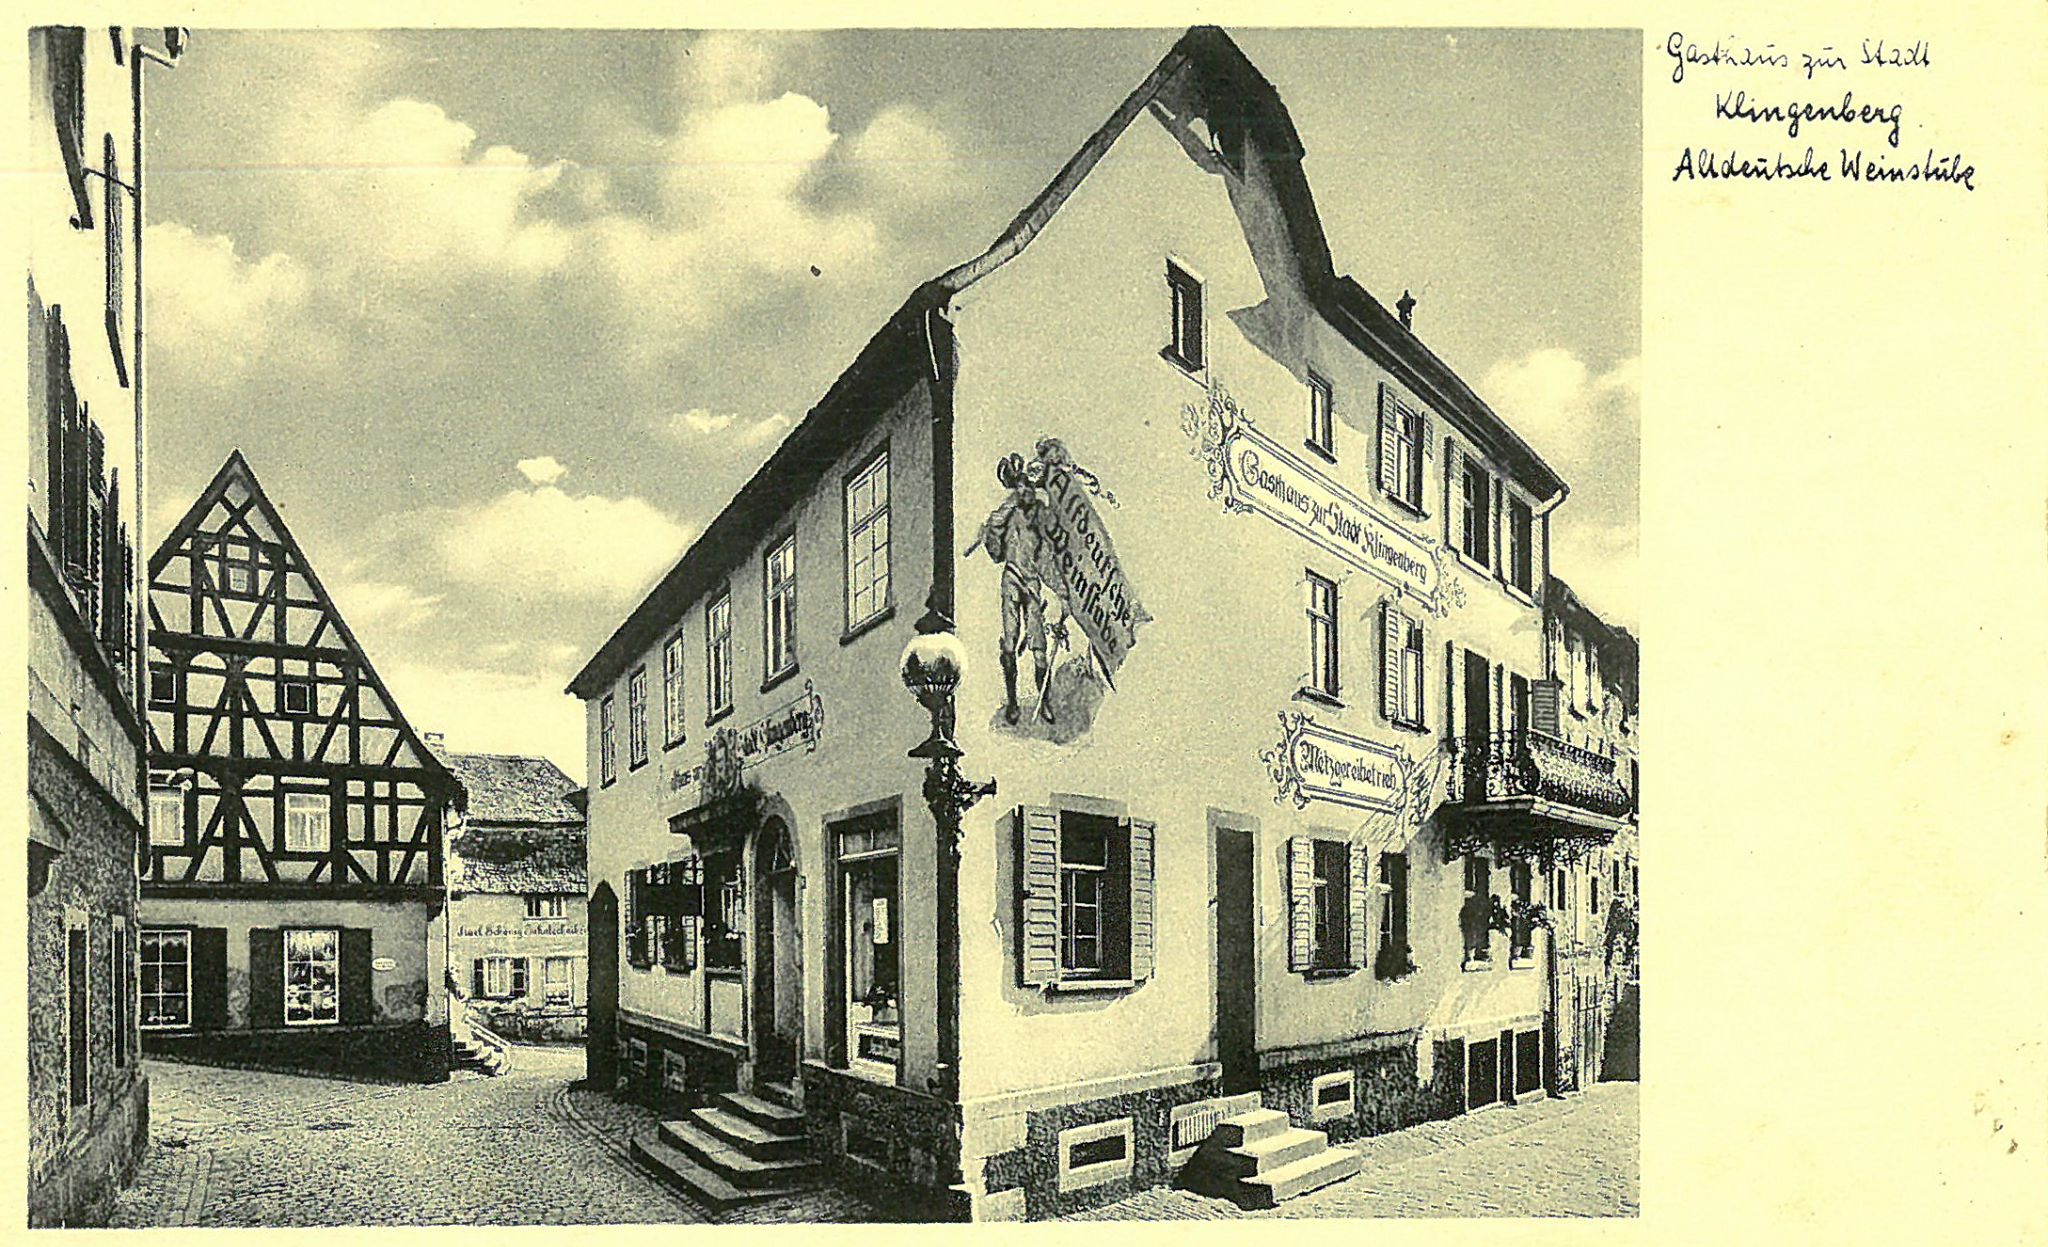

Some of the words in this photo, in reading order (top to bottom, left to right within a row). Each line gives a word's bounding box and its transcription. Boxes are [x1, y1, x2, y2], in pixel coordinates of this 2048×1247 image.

[1667, 32, 1789, 83] Gasthaus
[1802, 47, 1847, 79] zur
[1861, 38, 1930, 68] Stadt
[1715, 90, 1903, 148] Klingenberg
[1672, 147, 1832, 182] Altdeutsche
[1841, 148, 1976, 191] Weinstube
[1240, 449, 1309, 514] Gasthaus
[1309, 500, 1333, 527] zur
[1327, 502, 1361, 545] Stadt
[1361, 523, 1427, 585] Klingenberg
[1299, 740, 1397, 790] Metzgereibetrieb
